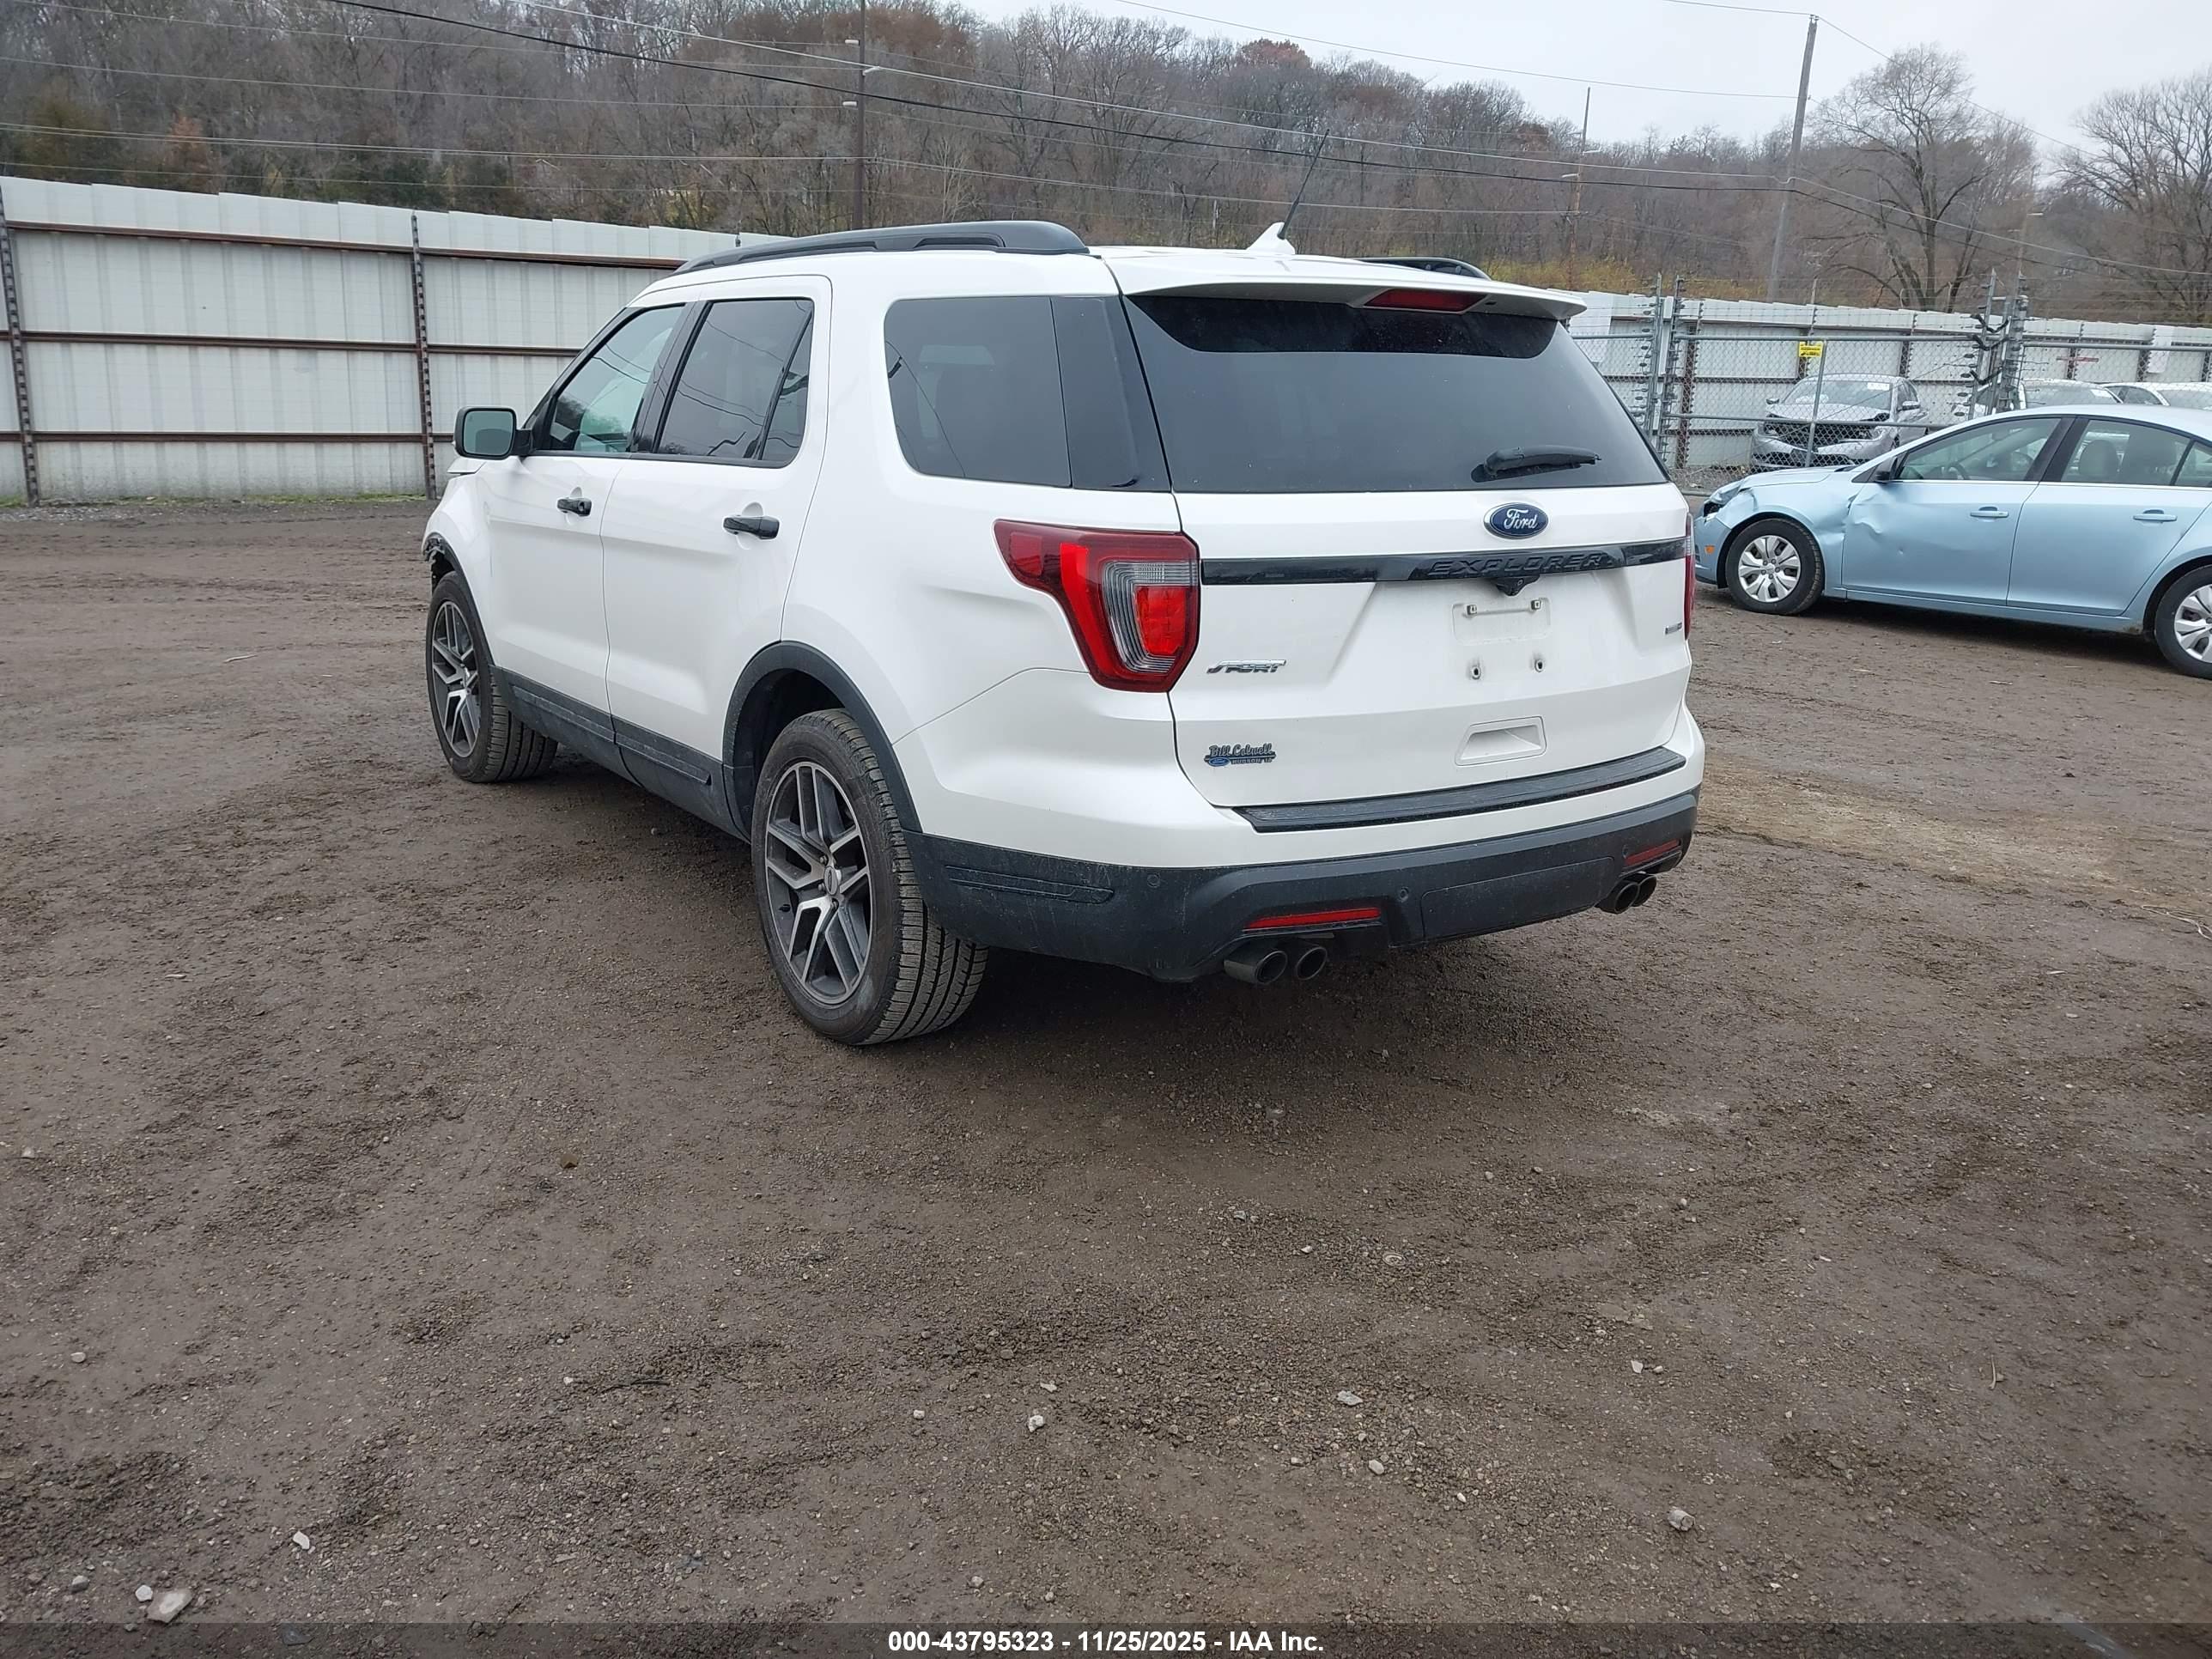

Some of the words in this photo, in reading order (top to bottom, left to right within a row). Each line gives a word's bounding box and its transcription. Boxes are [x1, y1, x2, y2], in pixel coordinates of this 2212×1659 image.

[1504, 508, 1539, 530] Ford
[1427, 552, 1604, 575] EXPLORER
[1206, 659, 1287, 674] SPORT
[1208, 744, 1231, 757] Bill
